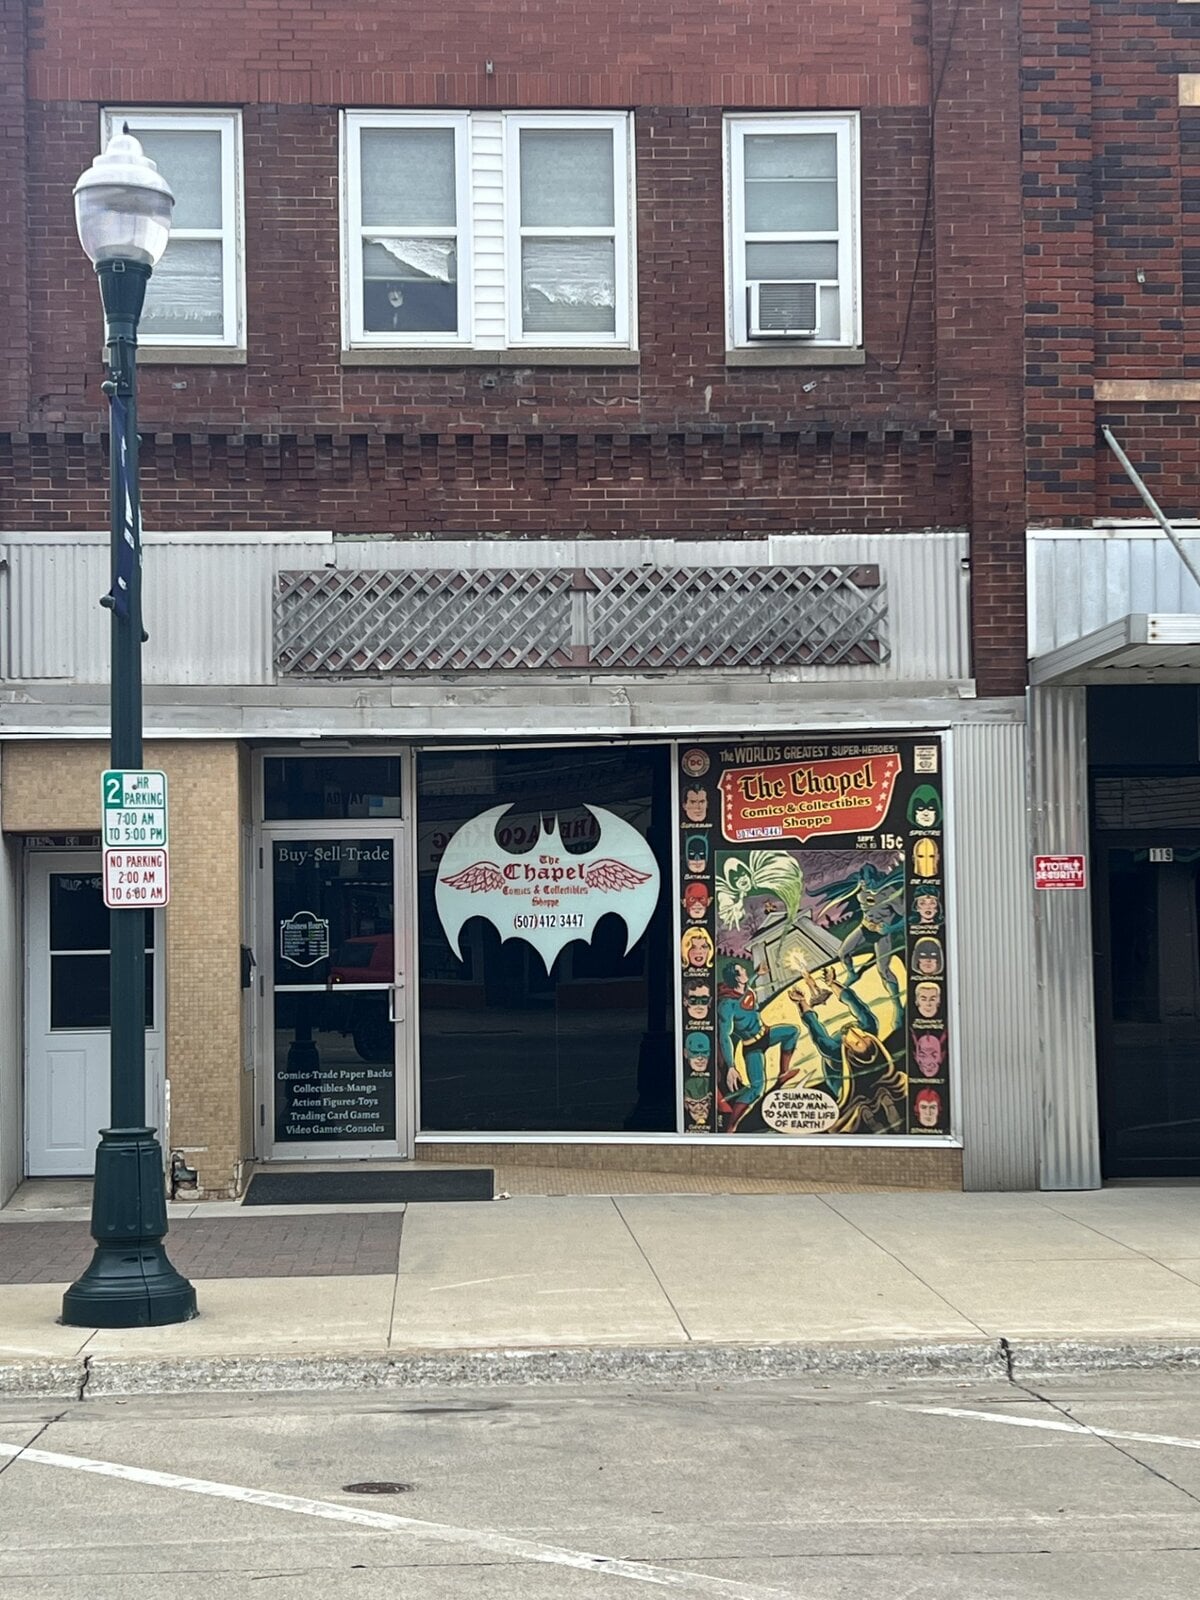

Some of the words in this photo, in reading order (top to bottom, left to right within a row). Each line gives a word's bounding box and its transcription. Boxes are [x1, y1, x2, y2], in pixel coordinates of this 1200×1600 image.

[735, 747, 781, 763] WORLD'S
[784, 746, 829, 759] GREATEST
[831, 745, 898, 756] SUPER-HEROES!
[739, 774, 784, 800] The
[790, 763, 874, 795] Chapel
[106, 778, 120, 803] 2
[136, 776, 149, 789] HR
[124, 792, 162, 805] PARKING
[742, 808, 784, 818] Comics
[786, 803, 797, 813] &
[799, 797, 871, 811] Collectibles
[116, 812, 137, 825] 7:00
[141, 812, 154, 825] AM
[783, 815, 832, 828] Shoppe
[109, 828, 120, 840] TO
[125, 828, 146, 840] 5:00
[150, 828, 163, 840] PM
[879, 833, 904, 849] 15¢
[278, 846, 390, 865] Buy-Sell-Trade
[539, 855, 560, 865] The
[1151, 849, 1172, 861] 119
[110, 856, 121, 868] NO
[126, 856, 162, 868] PARKING
[118, 871, 139, 884] 2:00
[143, 871, 155, 883] AM
[503, 864, 585, 882] Chapel
[1036, 870, 1083, 880] SECURITY
[111, 888, 121, 900] TO
[150, 887, 163, 899] AM
[502, 886, 531, 896] Comics
[533, 885, 540, 895] &
[543, 885, 589, 895] Collectibles
[531, 896, 560, 908] Shoppe
[513, 914, 538, 929] (507)
[539, 915, 556, 928] 412
[559, 913, 584, 927] 3447
[277, 1070, 338, 1080] Comics-Trade
[340, 1070, 366, 1080] Paper
[367, 1069, 393, 1078] Backs
[293, 1083, 377, 1094] Collectibles-Manga
[292, 1098, 321, 1107] Action
[323, 1097, 378, 1108] Figures-Toys
[774, 1093, 780, 1101] I
[782, 1093, 822, 1101] SUMMON
[290, 1111, 326, 1122] Trading
[327, 1111, 349, 1120] Card
[350, 1110, 380, 1119] Games
[764, 1110, 775, 1118] TO
[776, 1110, 799, 1119] SAVE
[800, 1111, 816, 1119] THE
[817, 1111, 836, 1119] LIFE
[286, 1125, 312, 1135] Video
[312, 1123, 385, 1134] Games-Consoles
[775, 1119, 789, 1128] OF
[790, 1119, 825, 1128] EARTH!
